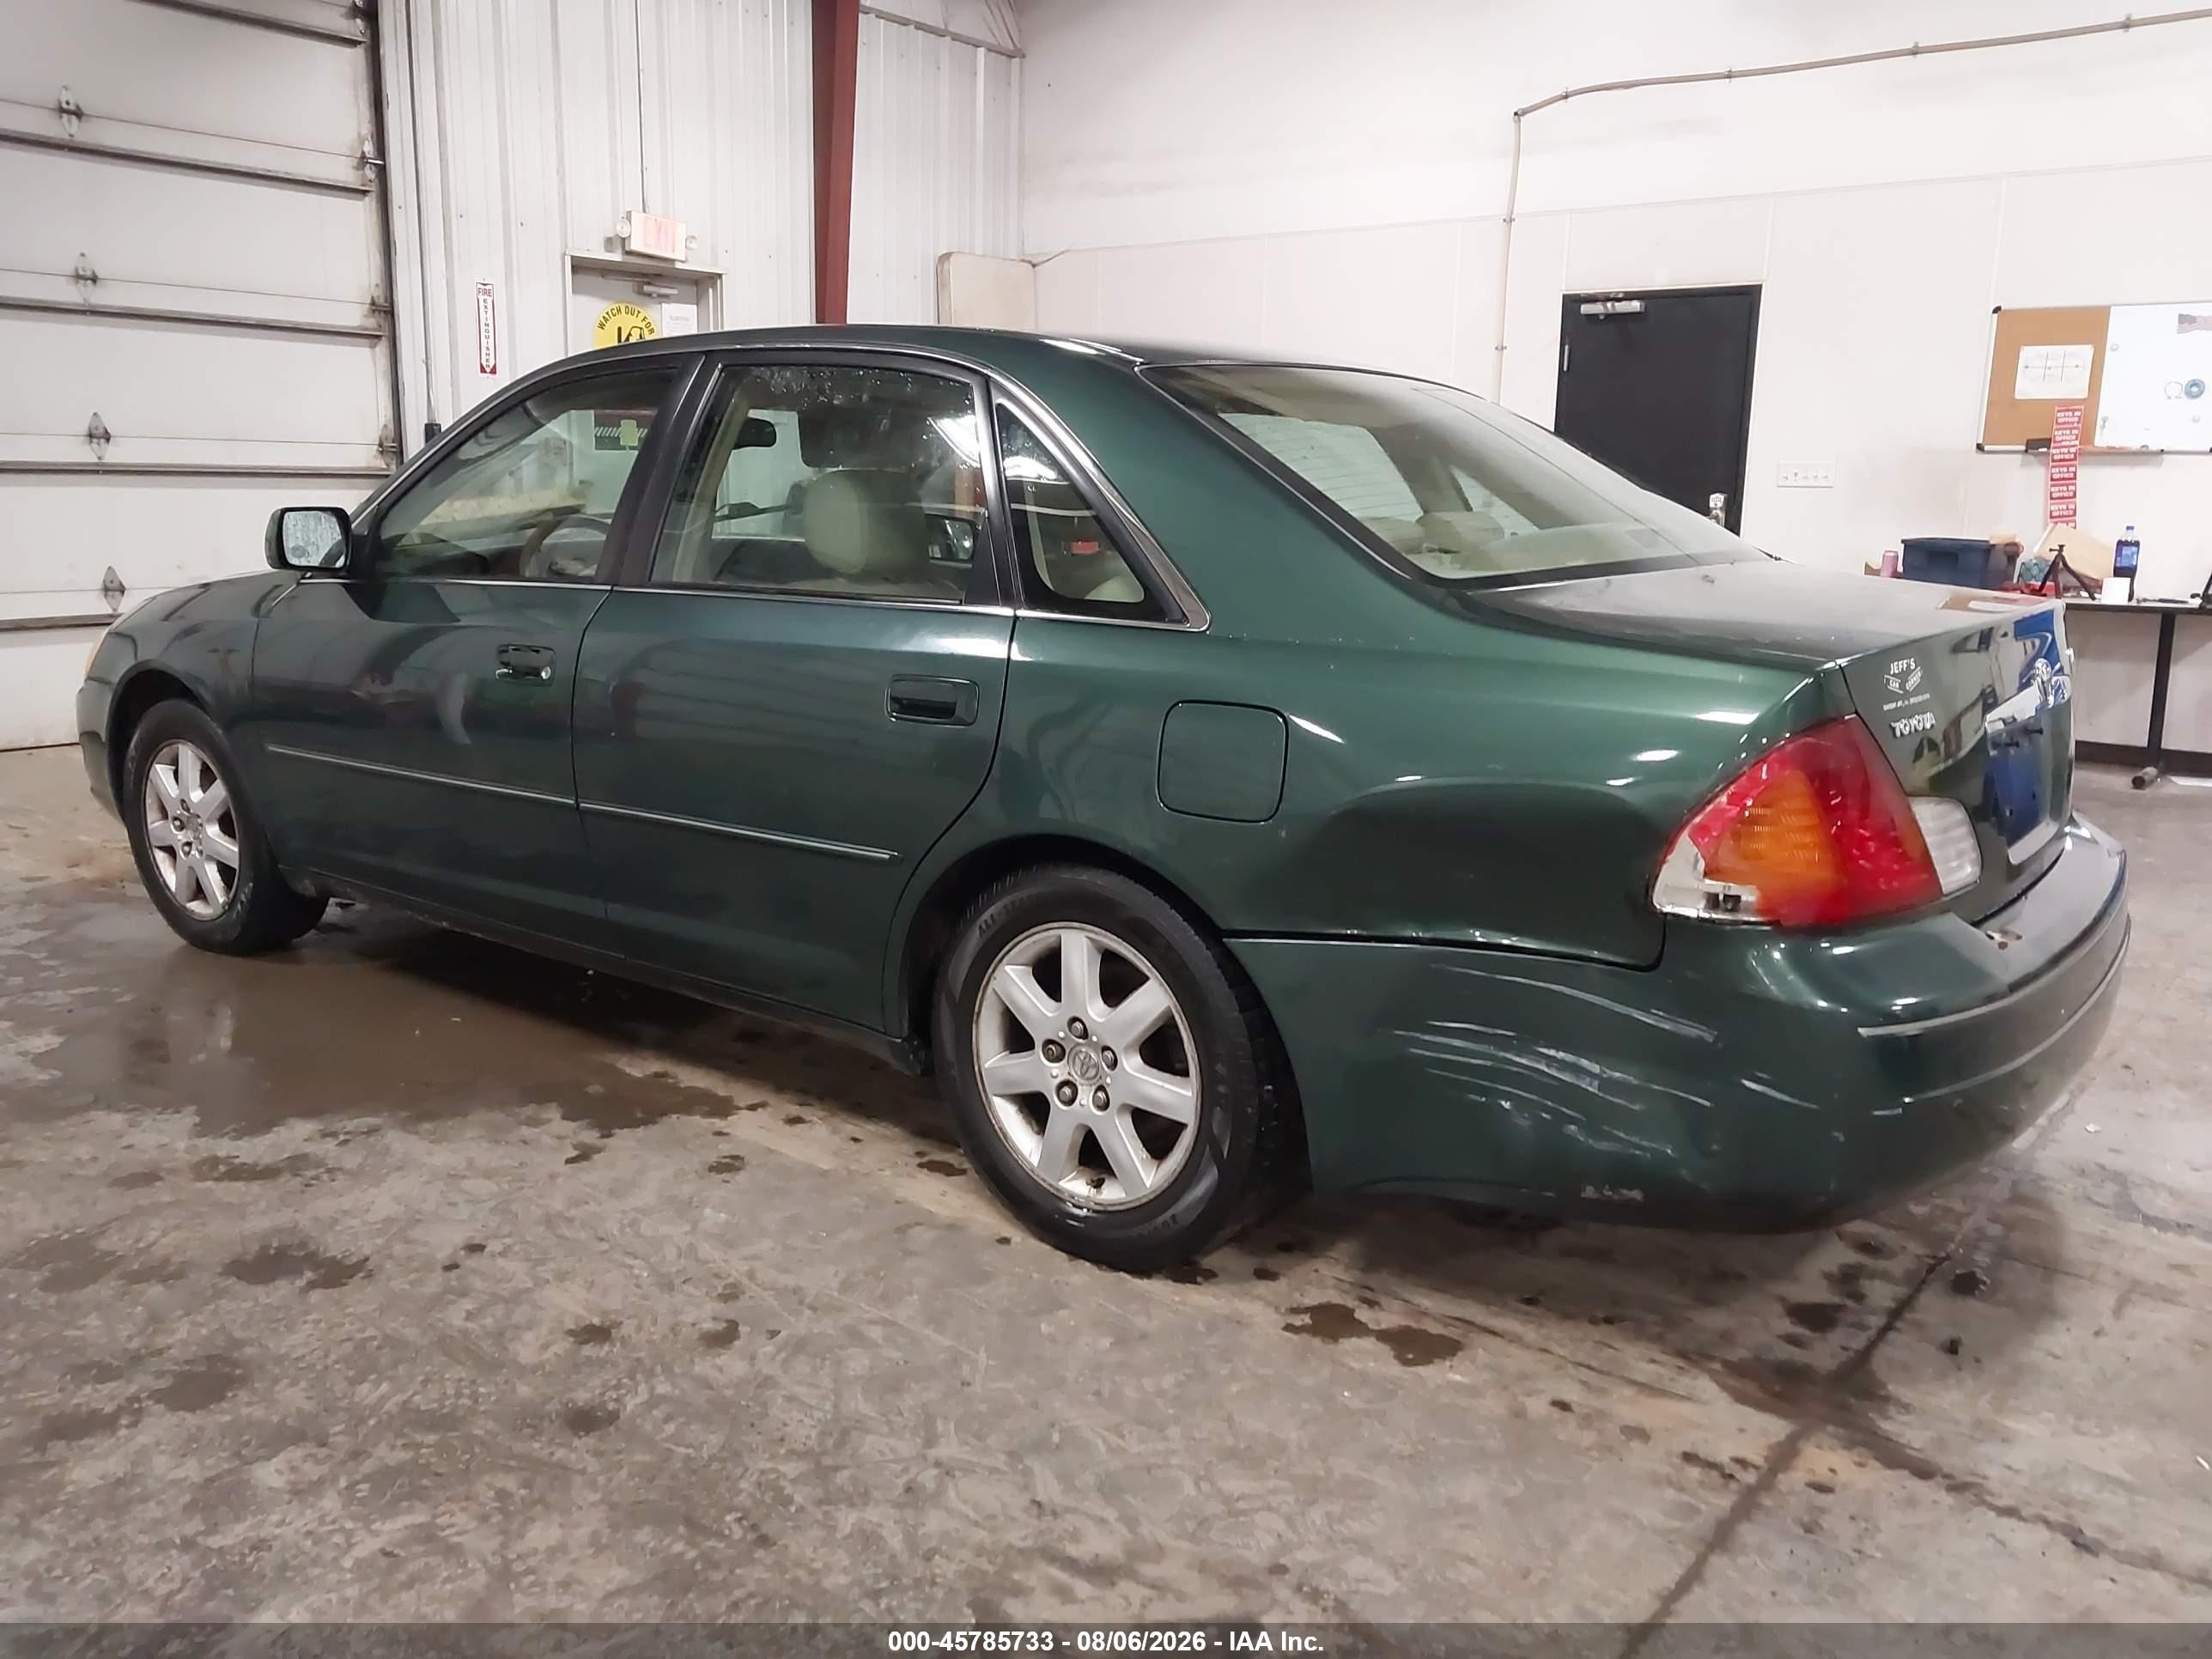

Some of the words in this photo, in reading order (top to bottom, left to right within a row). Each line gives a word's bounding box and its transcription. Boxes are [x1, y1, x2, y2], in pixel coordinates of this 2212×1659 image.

[477, 288, 493, 297] FIRE
[598, 305, 623, 330] WATCH
[624, 305, 641, 319] OUT
[641, 315, 655, 335] FOR
[1890, 658, 1916, 675] JEFF'S
[1890, 711, 1937, 738] TOYOTA
